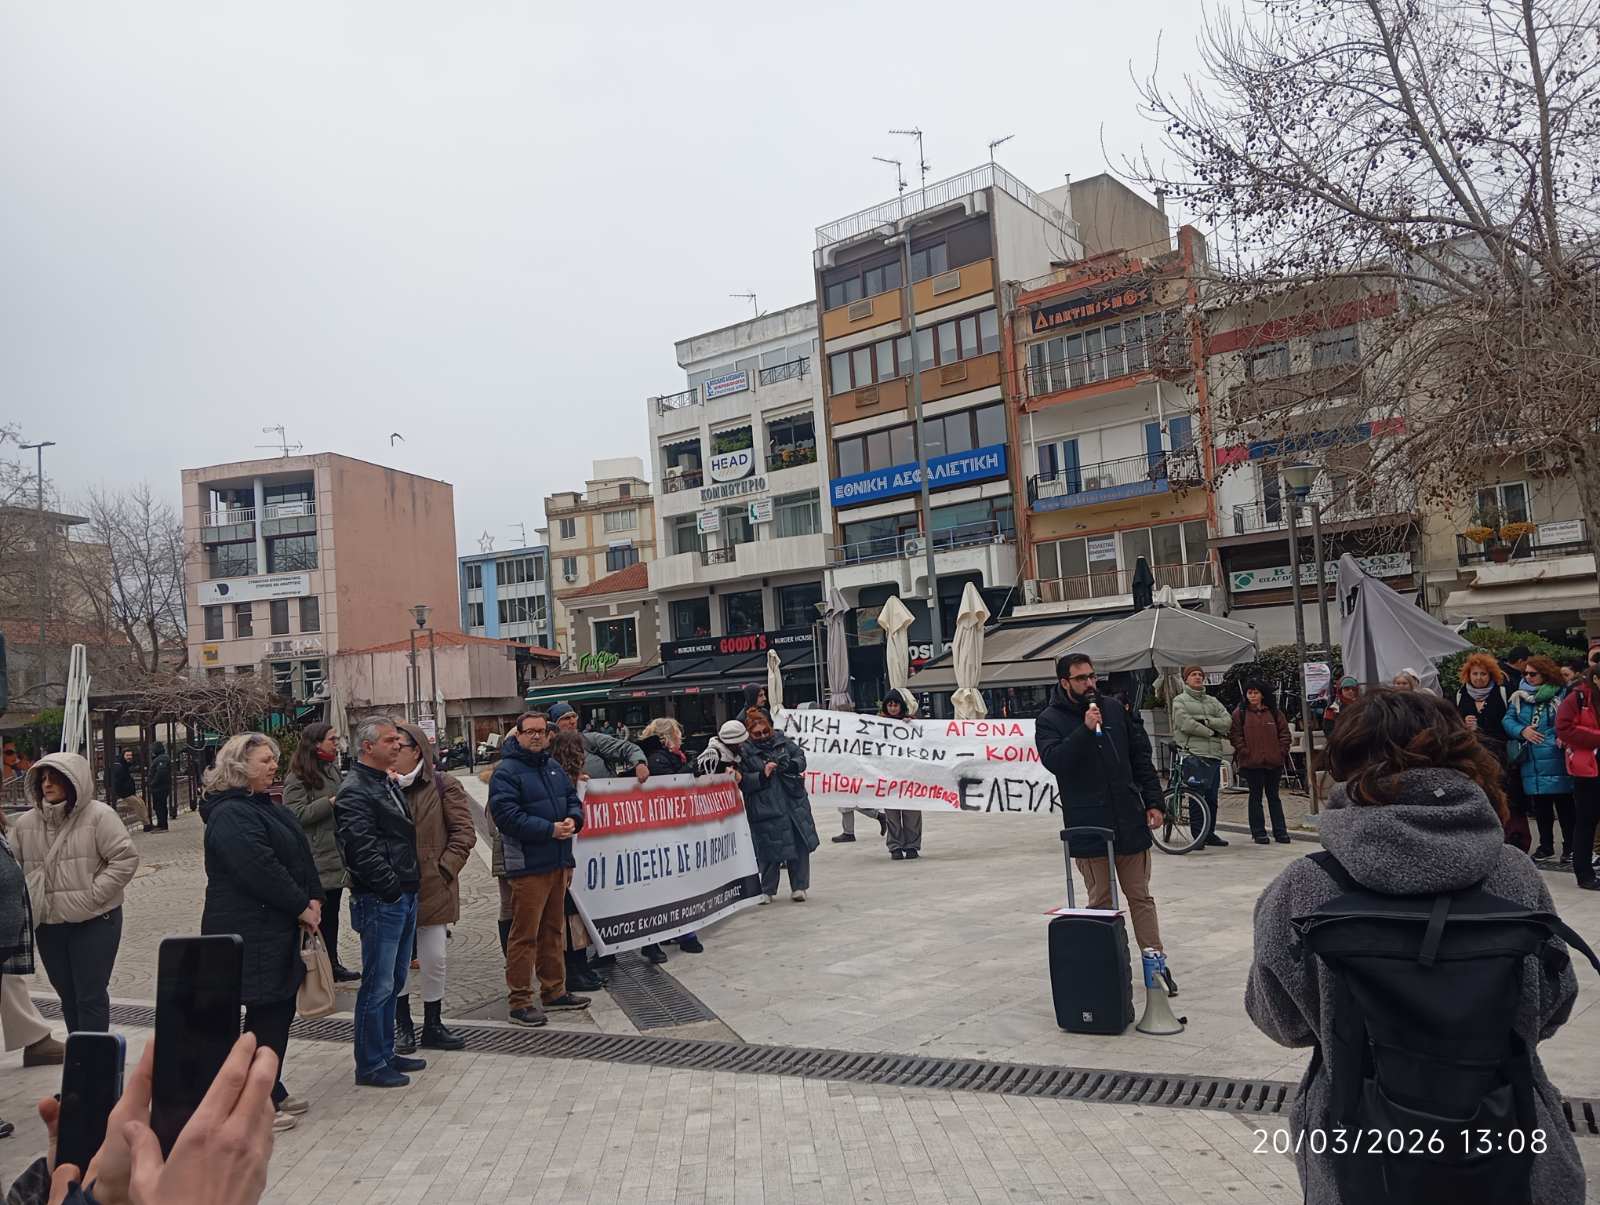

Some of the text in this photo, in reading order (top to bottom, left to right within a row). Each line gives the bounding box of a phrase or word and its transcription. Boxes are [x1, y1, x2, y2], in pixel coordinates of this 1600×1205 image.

[712, 454, 748, 471] HEAD
[701, 478, 766, 501] ΚΟΜΜΩΤΗΡΙΟ
[835, 477, 888, 499] ΕΘΝΙΚΗ
[720, 634, 767, 653] GOODY'S
[784, 714, 1024, 740] ΝΙΚΗ ΣΤΟΝ ΑΓΩΝΑ
[986, 745, 1041, 762] ΚΟΙΝ
[586, 801, 610, 829] ΙΚΗ
[614, 799, 646, 826] ΣΤΟΥΣ
[649, 797, 687, 821] ΑΓΩΝΕΣ
[587, 856, 606, 890] ΟΙ
[615, 847, 673, 886] ΔΙΩΞΕΙΣ
[678, 844, 691, 873] ΔΕ
[696, 841, 708, 869] ΘΑ
[597, 921, 635, 938] ΛΛΟΓΟΣ
